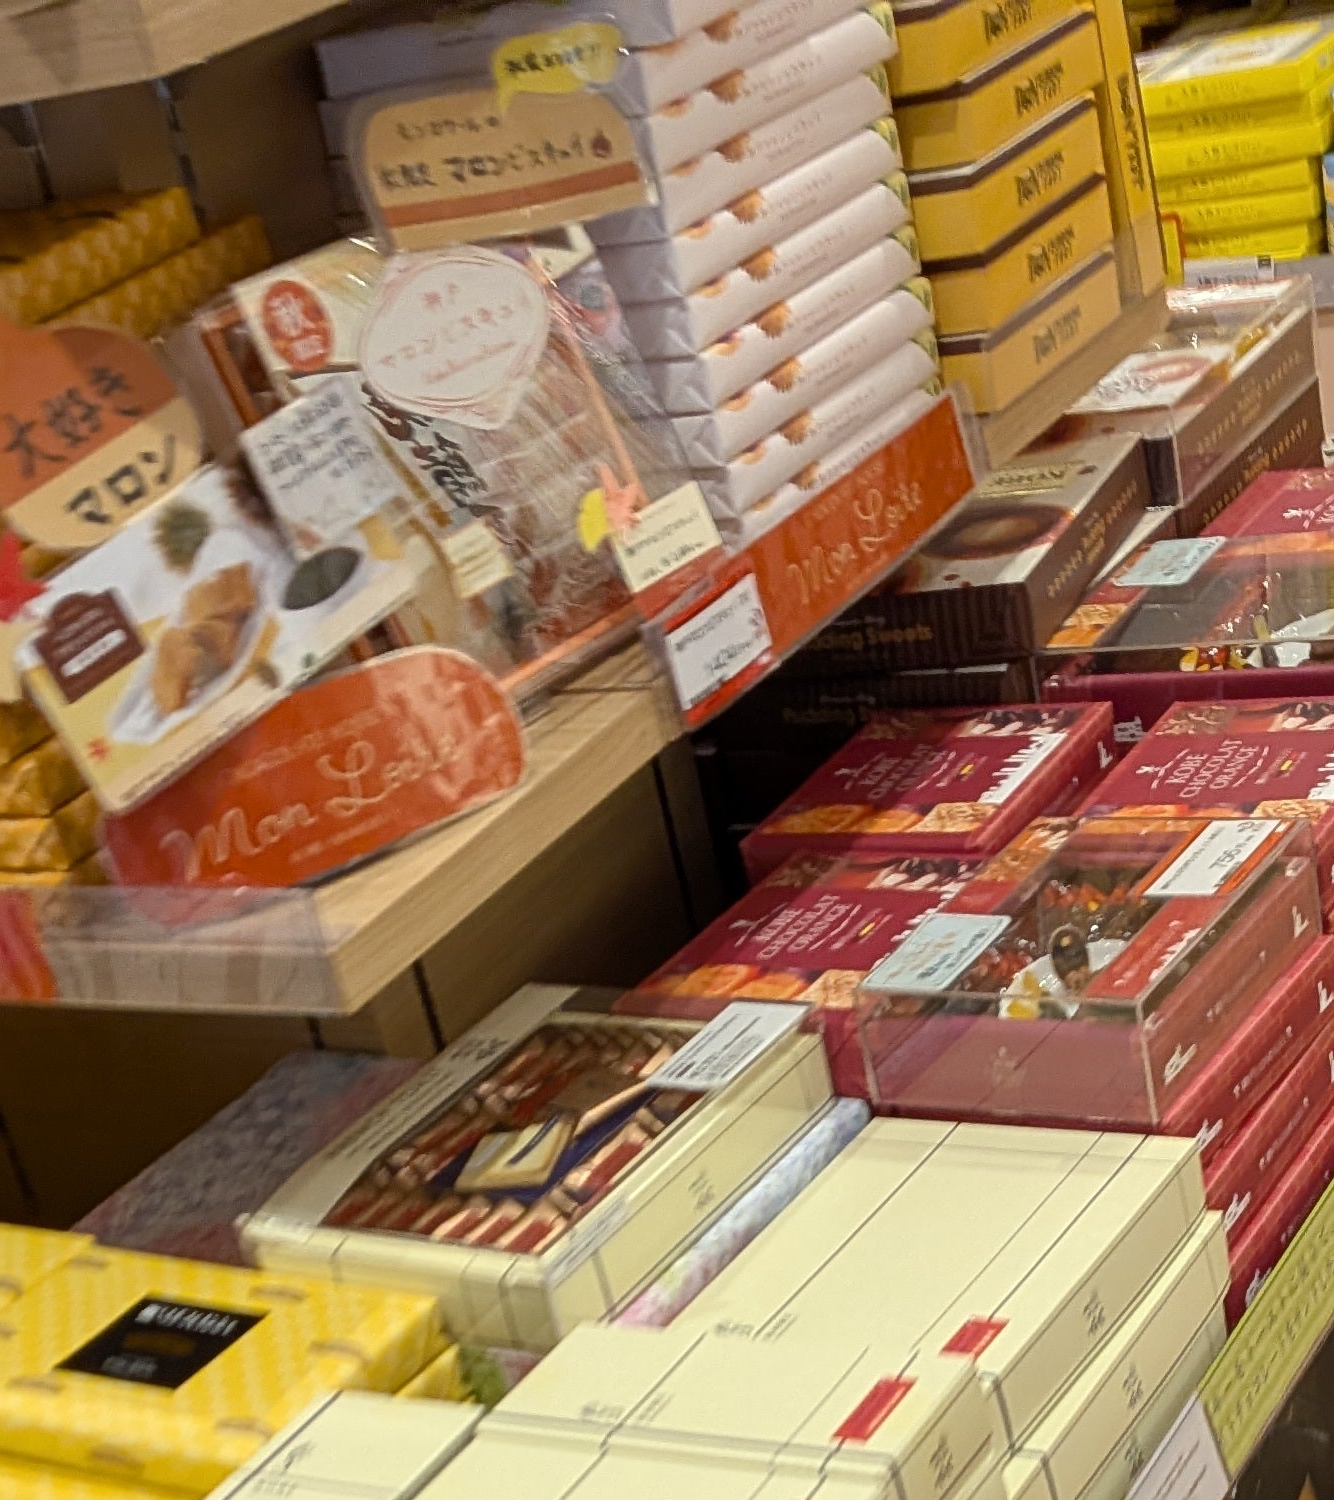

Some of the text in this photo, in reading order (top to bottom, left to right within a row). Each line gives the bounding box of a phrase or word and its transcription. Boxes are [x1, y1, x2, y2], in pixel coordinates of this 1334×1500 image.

[1, 366, 142, 478] 大好き
[66, 434, 175, 524] マロン
[786, 543, 857, 605] Mon
[1165, 753, 1209, 785] KOBE
[1179, 738, 1243, 798] CHOCOLAT
[1209, 745, 1259, 790] ORANGE
[160, 804, 319, 883] Mon
